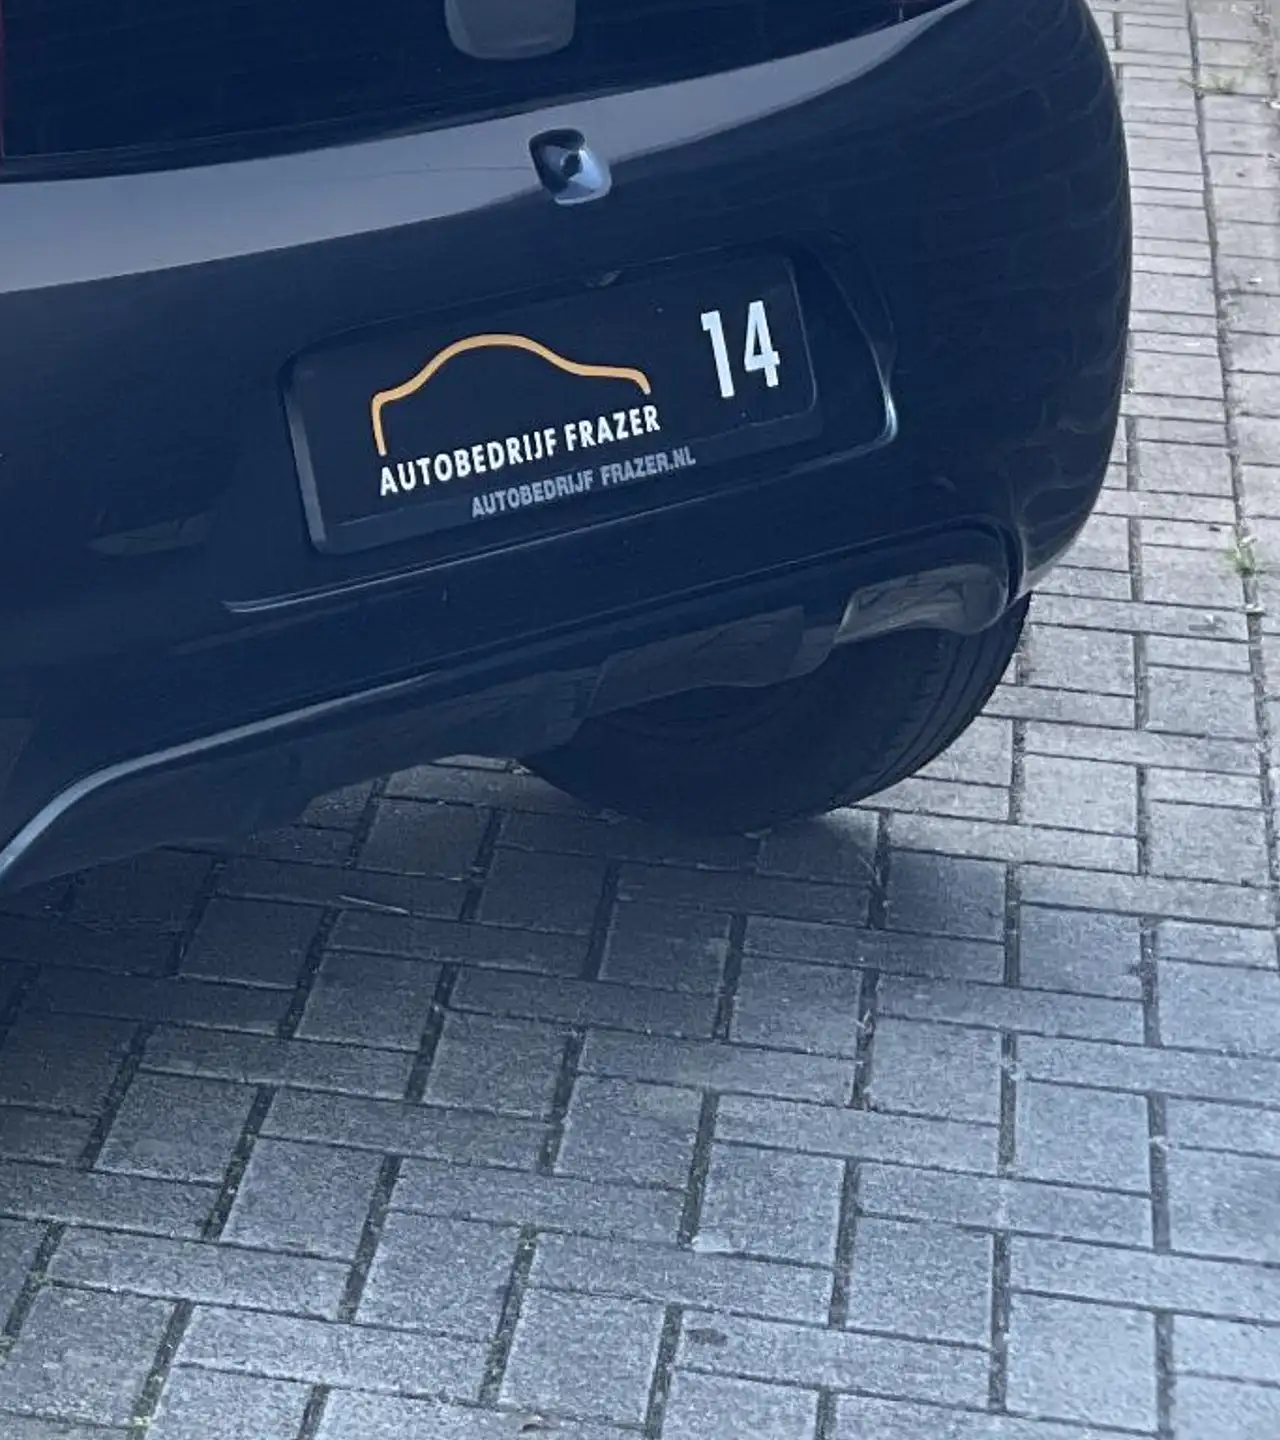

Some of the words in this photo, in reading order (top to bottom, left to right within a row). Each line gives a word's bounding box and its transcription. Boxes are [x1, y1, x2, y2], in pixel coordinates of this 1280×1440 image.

[701, 300, 780, 398] 14
[379, 427, 557, 497] AUTOBEDRIJF
[564, 404, 661, 452] FRAZER
[471, 469, 595, 519] AUTOBEDRIJF
[600, 445, 697, 487] FRAZER.NL
